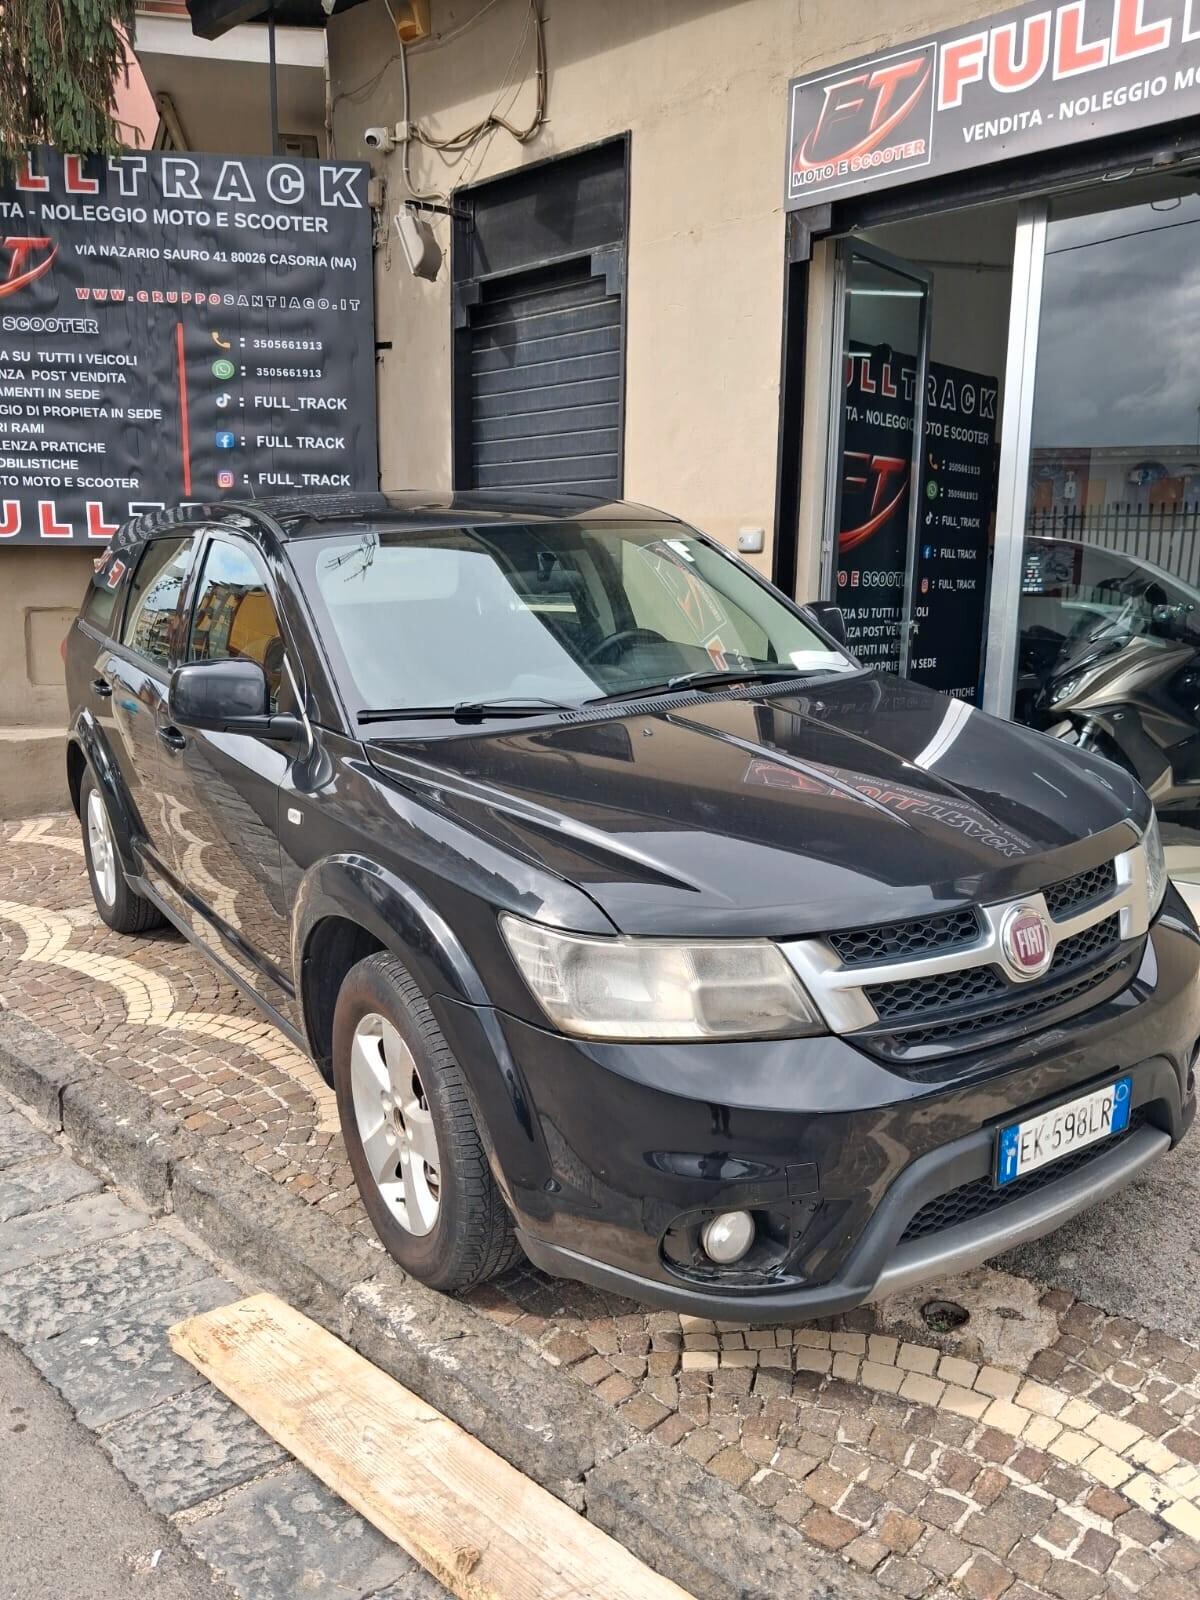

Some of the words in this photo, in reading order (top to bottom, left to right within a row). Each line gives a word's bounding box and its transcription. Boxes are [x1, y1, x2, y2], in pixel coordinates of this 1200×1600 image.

[962, 109, 1042, 143] VENDITA
[1058, 76, 1167, 121] NOLEGGIO
[792, 164, 834, 187] MOTO
[837, 159, 849, 176] E
[850, 138, 926, 172] SCOOTER
[0, 202, 24, 218] TA
[41, 204, 147, 223] NOLEGGIO
[153, 209, 210, 226] MOTO
[216, 212, 229, 227] E
[234, 212, 328, 232] SCOOTER
[75, 245, 97, 256] VIA
[99, 246, 160, 259] NAZARIO
[163, 248, 210, 261] SAURO
[212, 251, 228, 263] 41
[230, 252, 266, 264] 80026
[269, 253, 328, 268] CASORIA
[330, 256, 357, 271] (NA)
[75, 287, 361, 311] WWW.GRUPPOSANTIAGO.IT
[2, 316, 99, 334] SCOOTER
[253, 339, 323, 351] 3505661913
[12, 351, 31, 361] SU
[37, 351, 75, 364] TUTTI
[78, 353, 82, 363] I
[85, 353, 138, 366] VEICOLI
[31, 369, 67, 381] POST
[70, 371, 127, 383] VENDITA
[256, 367, 322, 378] 3505661913
[49, 388, 61, 399] IN
[65, 389, 100, 400] SEDE
[254, 396, 348, 411] FULL_TRACK
[0, 404, 23, 416] GIO
[26, 405, 40, 416] DI
[43, 406, 108, 418] PROPIETA
[111, 408, 123, 418] IN
[127, 409, 162, 420] SEDE
[11, 422, 45, 434] RAMI
[846, 406, 858, 421] TA
[943, 424, 950, 438] E
[951, 426, 989, 446] SCOOTER
[0, 440, 38, 451] ENZA
[41, 441, 106, 454] PRATICHE
[256, 435, 293, 448] FULL
[296, 436, 345, 449] TRACK
[0, 475, 19, 486] TO
[22, 476, 61, 487] MOTO
[64, 477, 73, 487] E
[76, 477, 139, 489] SCOOTER
[258, 472, 351, 488] FULL_TRACK
[837, 570, 847, 587] O
[850, 570, 860, 587] E
[858, 608, 869, 619] SU
[871, 607, 894, 618] TUTTI
[862, 626, 884, 637] POST
[880, 644, 889, 655] IN
[918, 658, 936, 669] SEDE
[1016, 924, 1044, 959] FIAT
